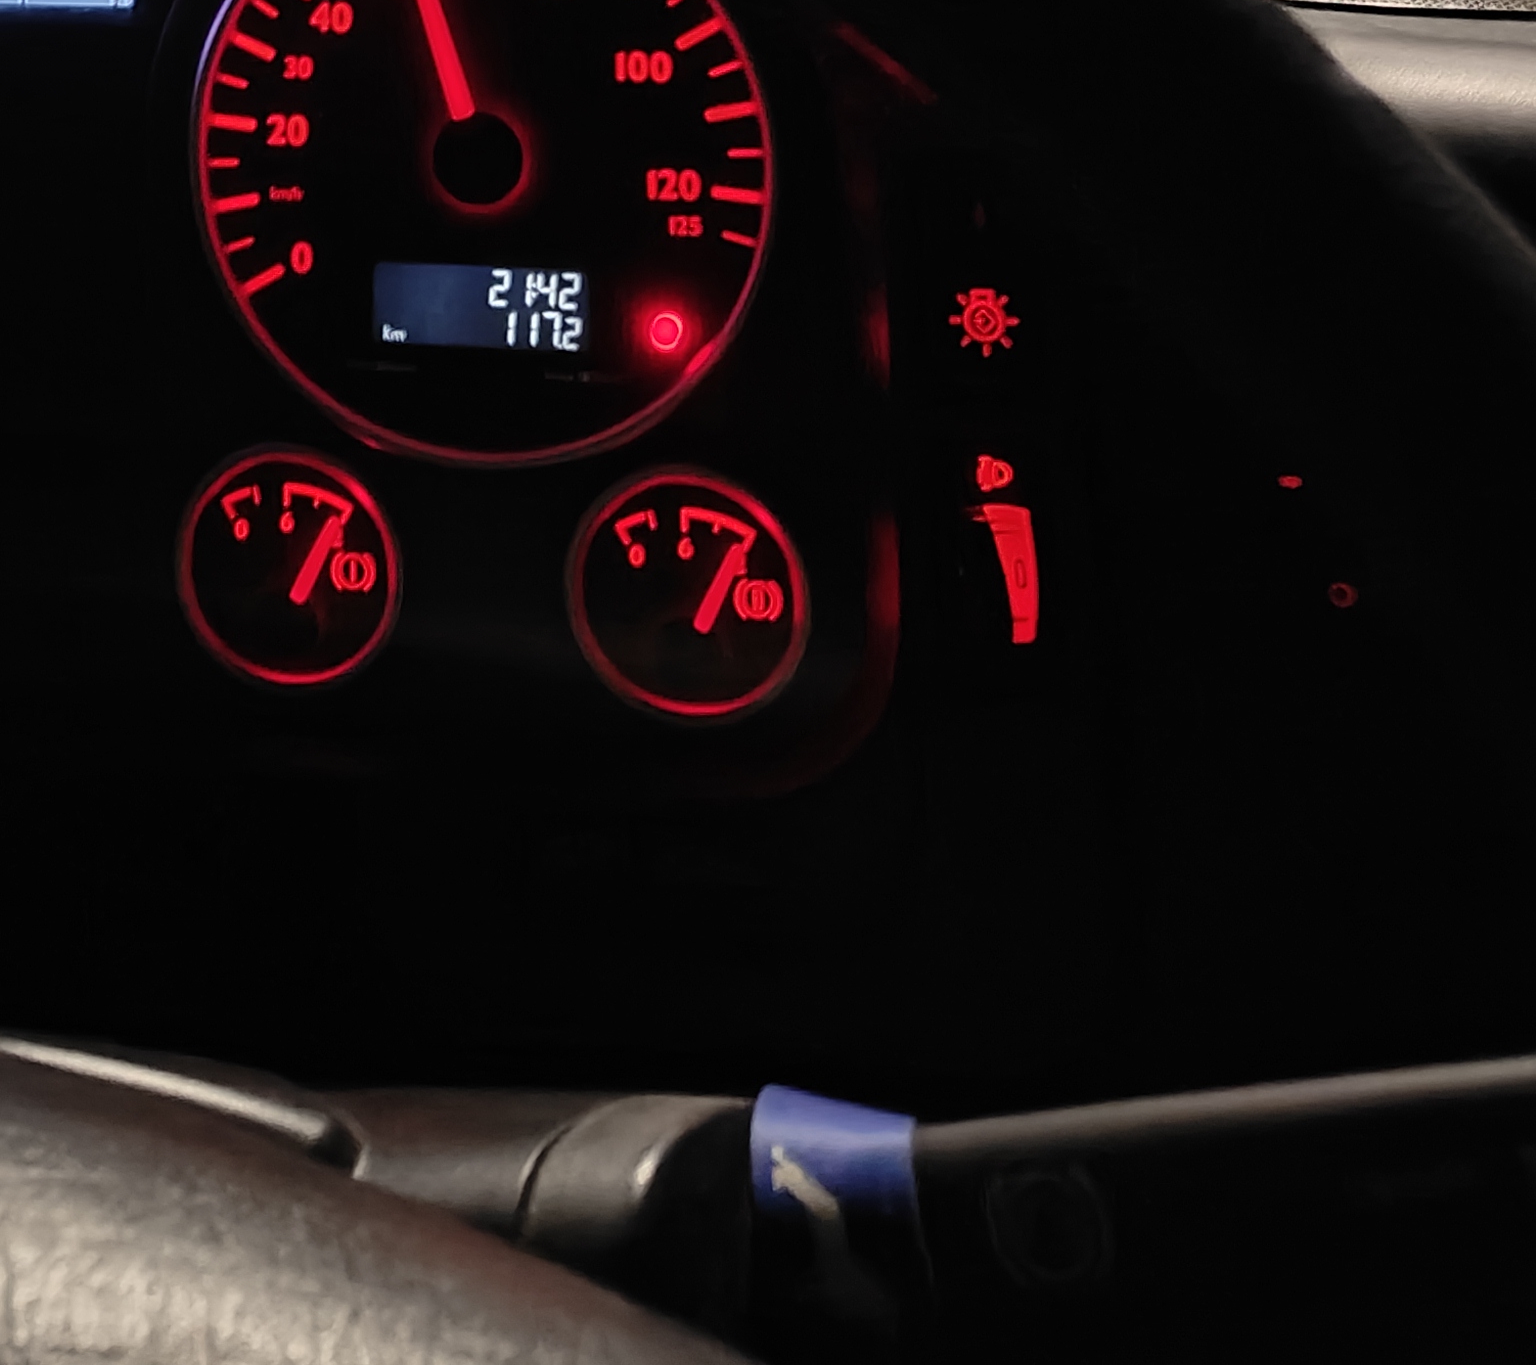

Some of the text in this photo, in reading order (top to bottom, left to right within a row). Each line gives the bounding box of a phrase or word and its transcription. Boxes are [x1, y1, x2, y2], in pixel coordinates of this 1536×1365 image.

[309, 2, 354, 34] 40
[283, 55, 313, 79] 30
[614, 52, 673, 83] 100
[267, 114, 309, 147] 20
[646, 168, 701, 201] 120
[668, 215, 703, 236] 125
[291, 241, 313, 273] 0
[383, 324, 407, 342] km
[234, 518, 250, 541] 0
[628, 544, 646, 568] 0
